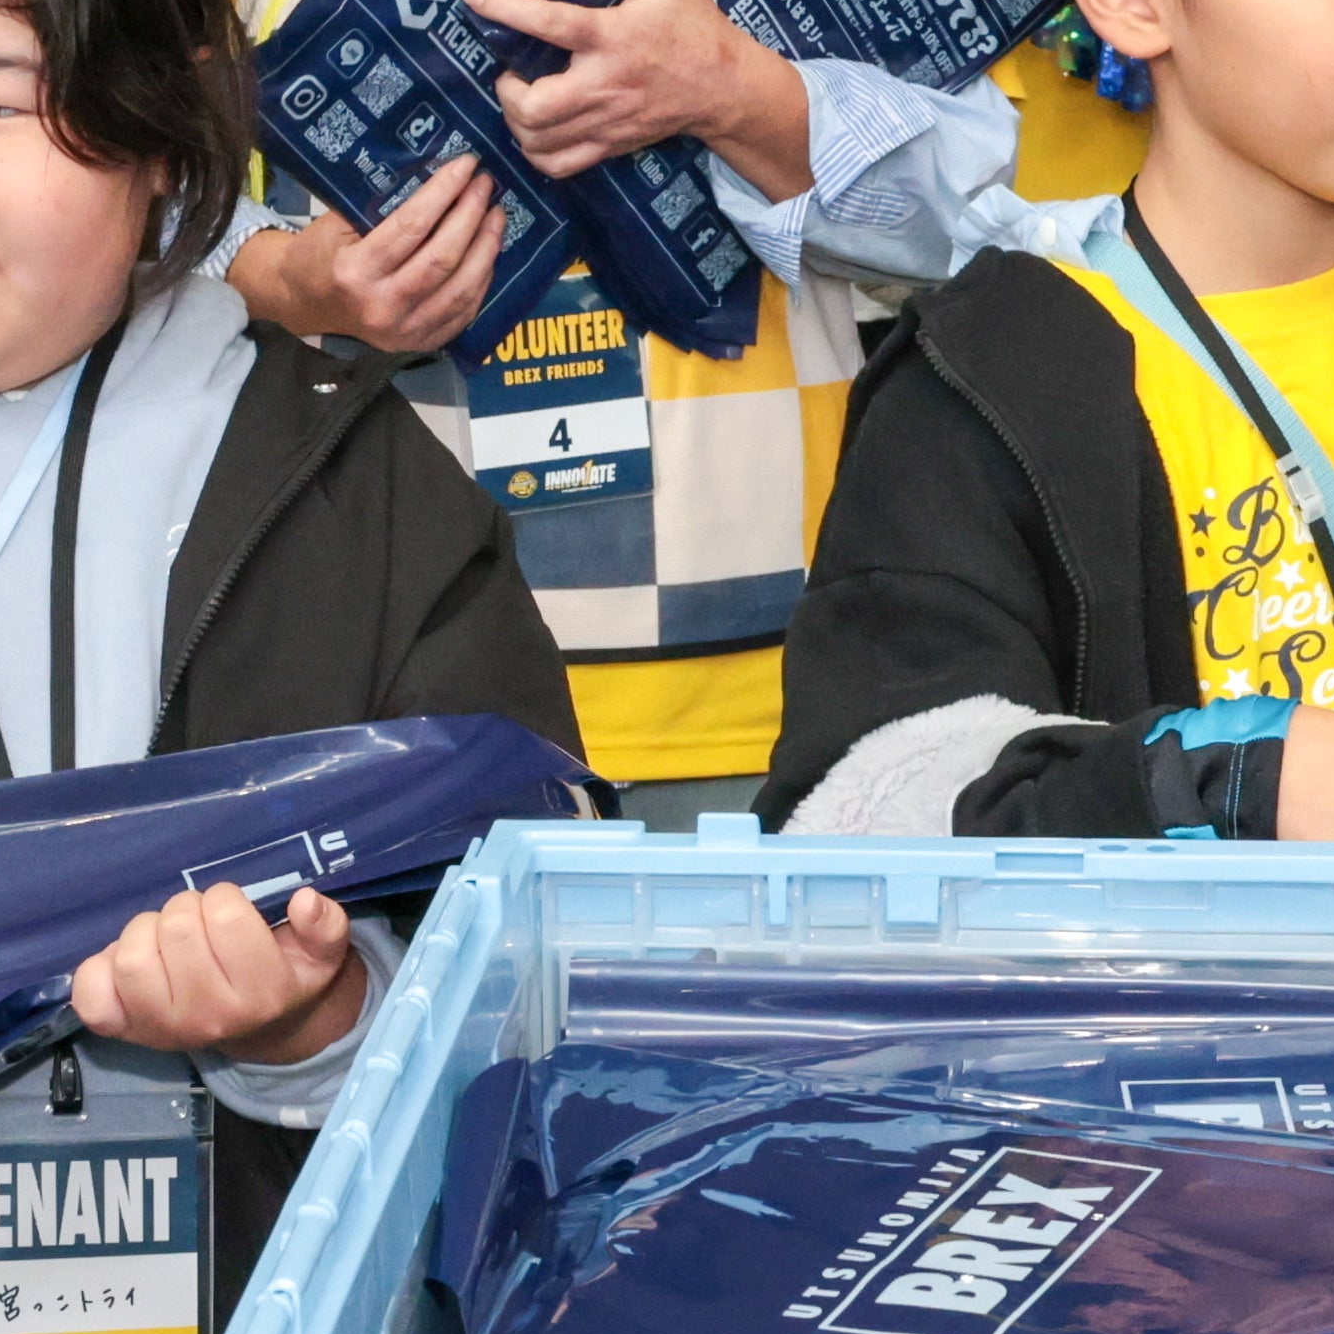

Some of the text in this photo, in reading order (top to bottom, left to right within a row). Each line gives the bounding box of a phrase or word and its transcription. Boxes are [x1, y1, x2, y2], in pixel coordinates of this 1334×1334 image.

[436, 13, 495, 77] TICKET
[353, 146, 394, 189] YouTub
[482, 308, 627, 365] OLUNTEER
[503, 360, 605, 387] BREX FRIENDS
[548, 418, 573, 452] 4
[782, 1147, 987, 1320] UTSUNOMIYA
[874, 1172, 1114, 1315] BREX
